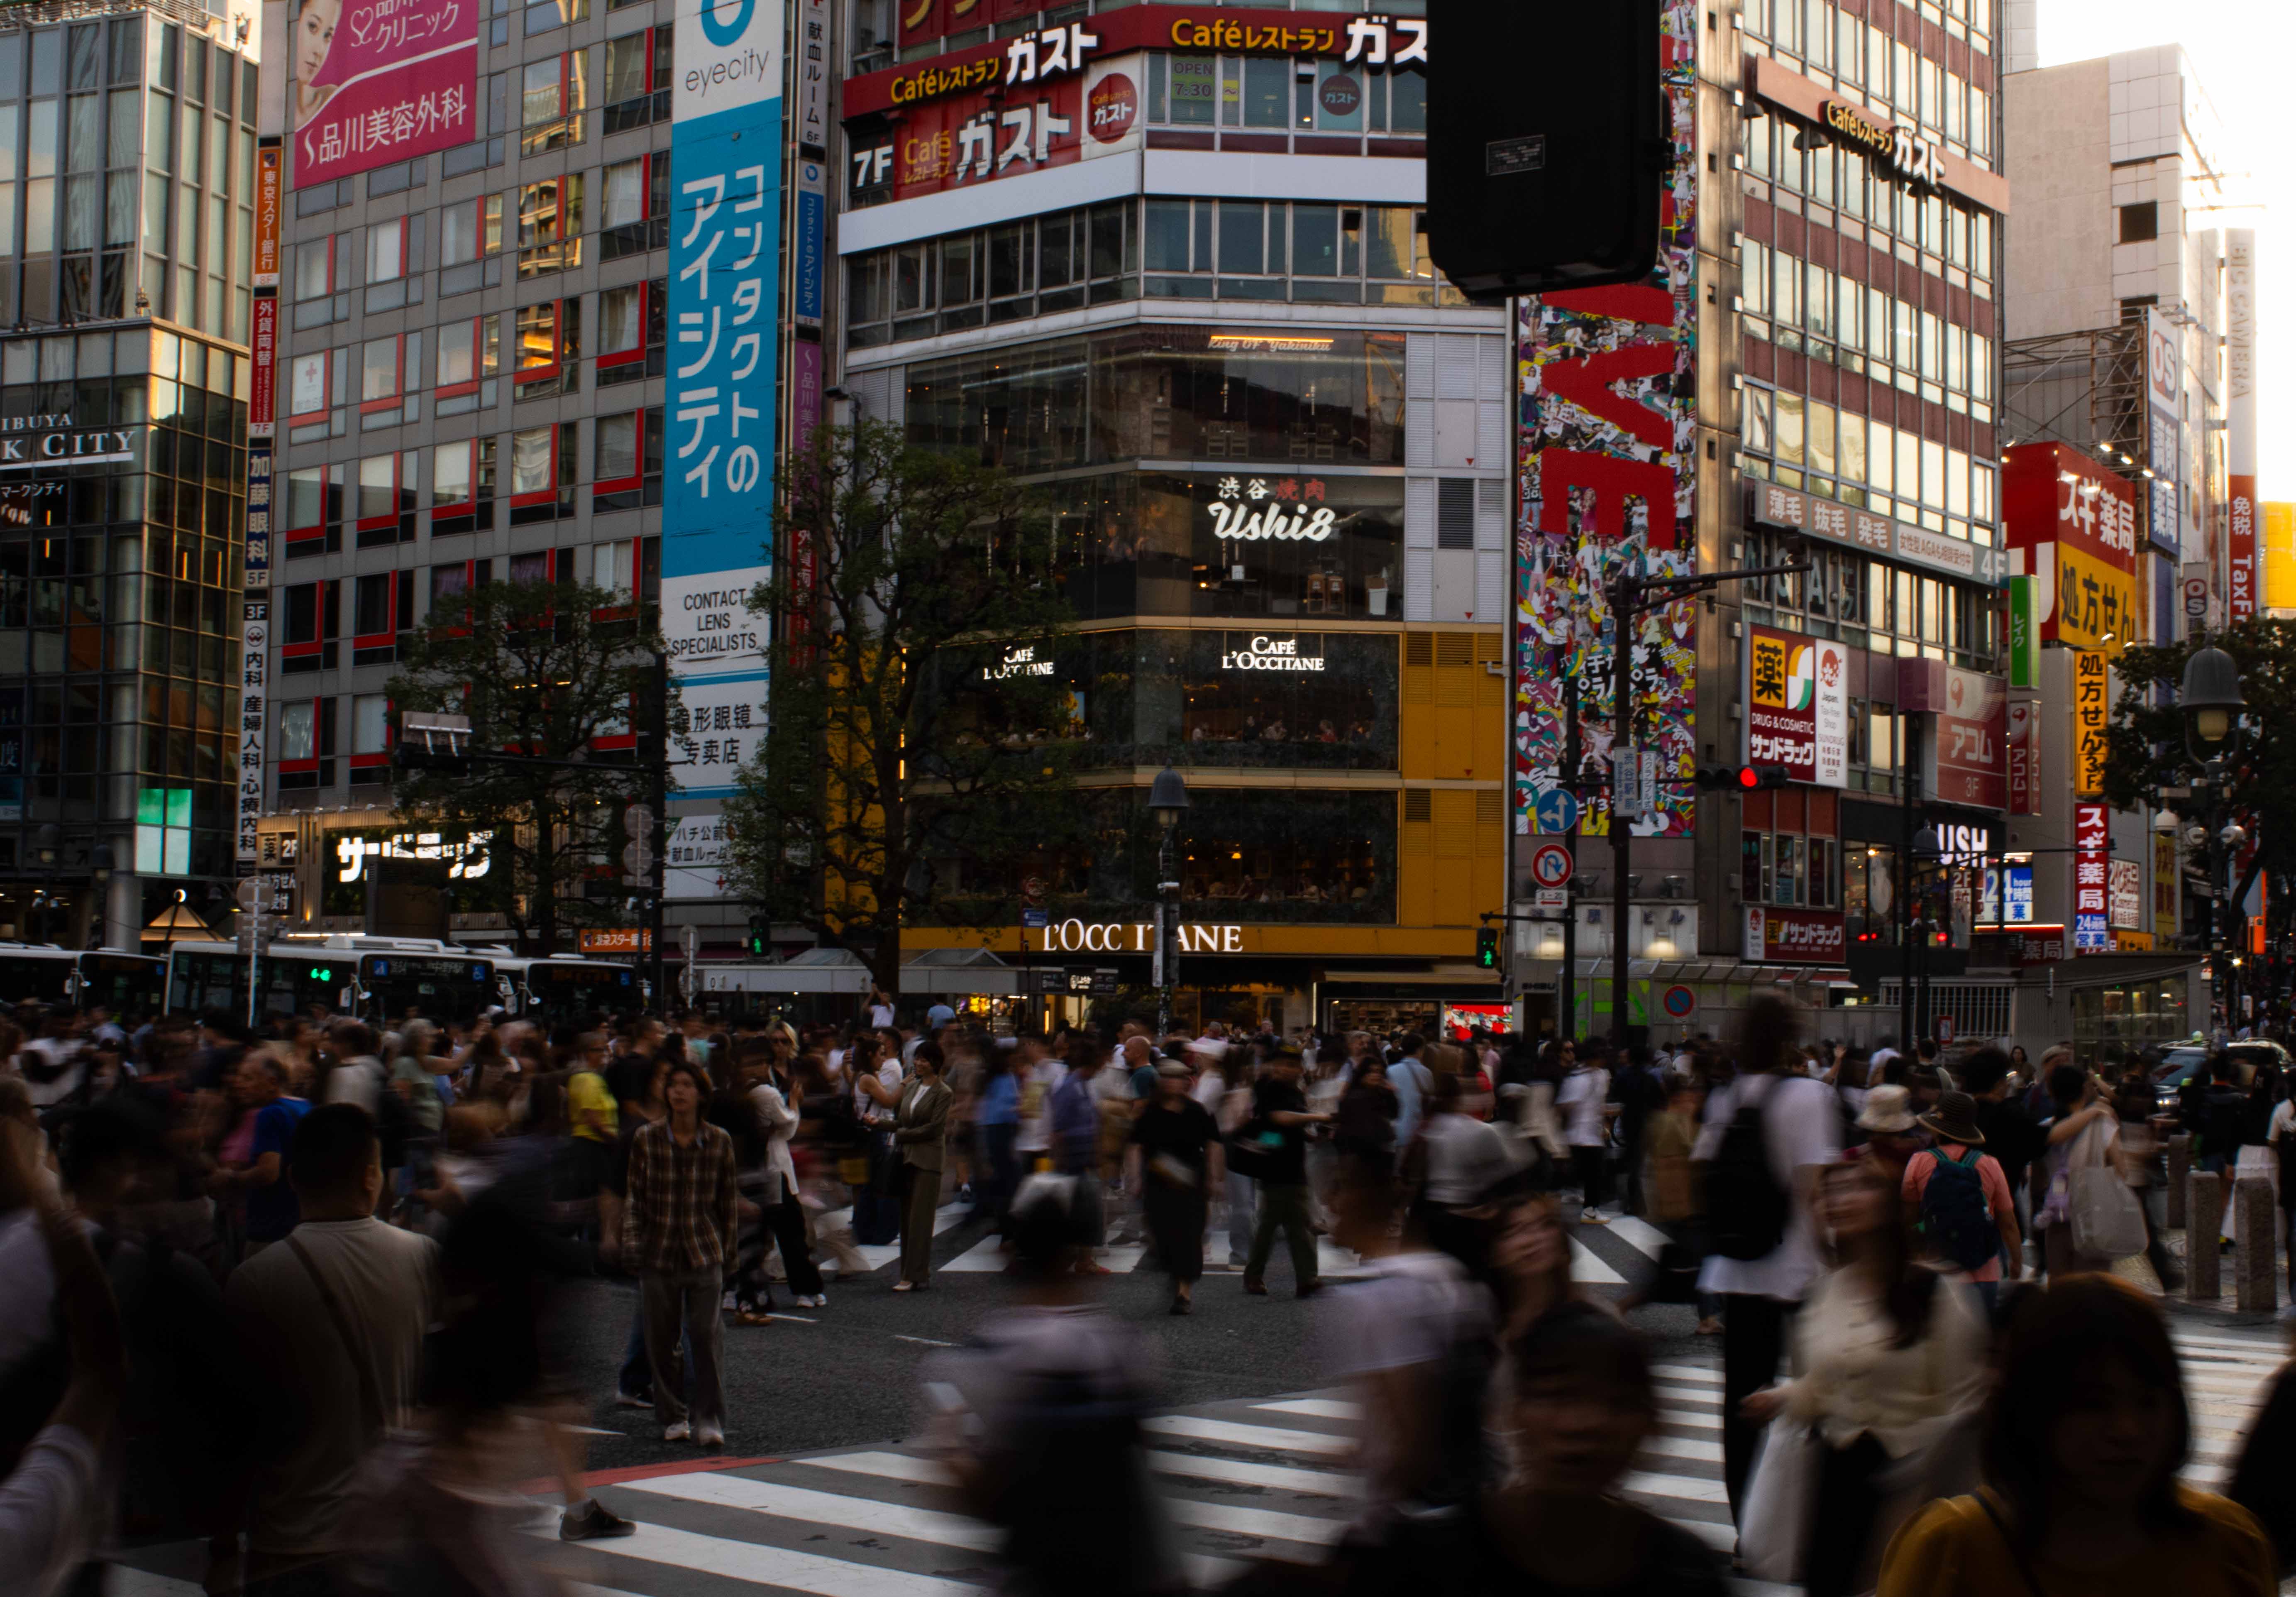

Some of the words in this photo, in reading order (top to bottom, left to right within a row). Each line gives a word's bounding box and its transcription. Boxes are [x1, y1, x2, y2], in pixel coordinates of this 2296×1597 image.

[376, 2, 459, 53] クリニック
[1169, 19, 1334, 51] Caféレストラン
[1345, 15, 1426, 64] ガス
[685, 48, 769, 98] eyecity
[806, 22, 823, 125] 献血ルーム
[891, 56, 999, 104] Caféレストラン
[1006, 22, 1098, 86] ガスト
[1174, 62, 1213, 76] OPEN
[1094, 101, 1132, 126] ガスト
[1324, 93, 1356, 104] ガスト
[319, 83, 467, 164] 品川美容外科
[806, 130, 819, 141] 6F
[904, 131, 950, 165] Café
[957, 103, 1070, 181] ガスト
[1894, 127, 1946, 186] ガスト
[855, 145, 893, 187] 7F
[261, 171, 276, 270] 東京スター銀行
[257, 301, 273, 366] 外貨両替
[677, 174, 725, 498] アイシティ
[725, 165, 765, 493] コンタクトの
[2152, 331, 2176, 392] OS
[43, 431, 135, 456] CITY
[254, 424, 269, 434] 7F
[1218, 477, 1325, 501] 渋谷焼肉
[249, 455, 270, 562] 加藤眼科
[1207, 501, 1335, 541] Ushi8
[2060, 470, 2134, 556] スギ薬局
[2232, 496, 2251, 536] 免税
[1769, 489, 1803, 525] 薄毛
[1814, 504, 1847, 537] 抜毛
[1857, 516, 1888, 549] 発毛
[1981, 550, 2006, 582] 4F
[249, 572, 266, 584] 5F
[247, 606, 265, 619] 3F
[684, 589, 746, 611] CONTACT
[2061, 560, 2135, 644] 処方せん
[2187, 581, 2204, 614] OS
[697, 612, 731, 631] LENS
[2013, 614, 2025, 647] レイク
[672, 632, 757, 656] SPECIALISTS
[1222, 651, 1325, 671] L'OCCITANE
[244, 652, 263, 687] 内科
[1755, 643, 1783, 701] 薬
[2079, 654, 2103, 752] 処方せん
[1751, 712, 1773, 727] DRUG
[1773, 716, 1779, 729] &
[1779, 717, 1815, 734] COSMETIC
[684, 738, 740, 765] 专卖店
[1750, 734, 1815, 765] サンドラッグ
[1951, 725, 1993, 764] アコム
[1966, 777, 1979, 797] 3F
[2012, 748, 2026, 791] アコム
[282, 839, 298, 857] 2F
[1937, 823, 1988, 868] USH
[2078, 808, 2105, 910] スギ薬局
[1043, 918, 1243, 951] L'OCCIANE
[1788, 922, 1842, 945] サンドラッグ
[2076, 916, 2091, 931] 24
[2078, 934, 2105, 946] 営業
[2022, 940, 2063, 960] 薬局
